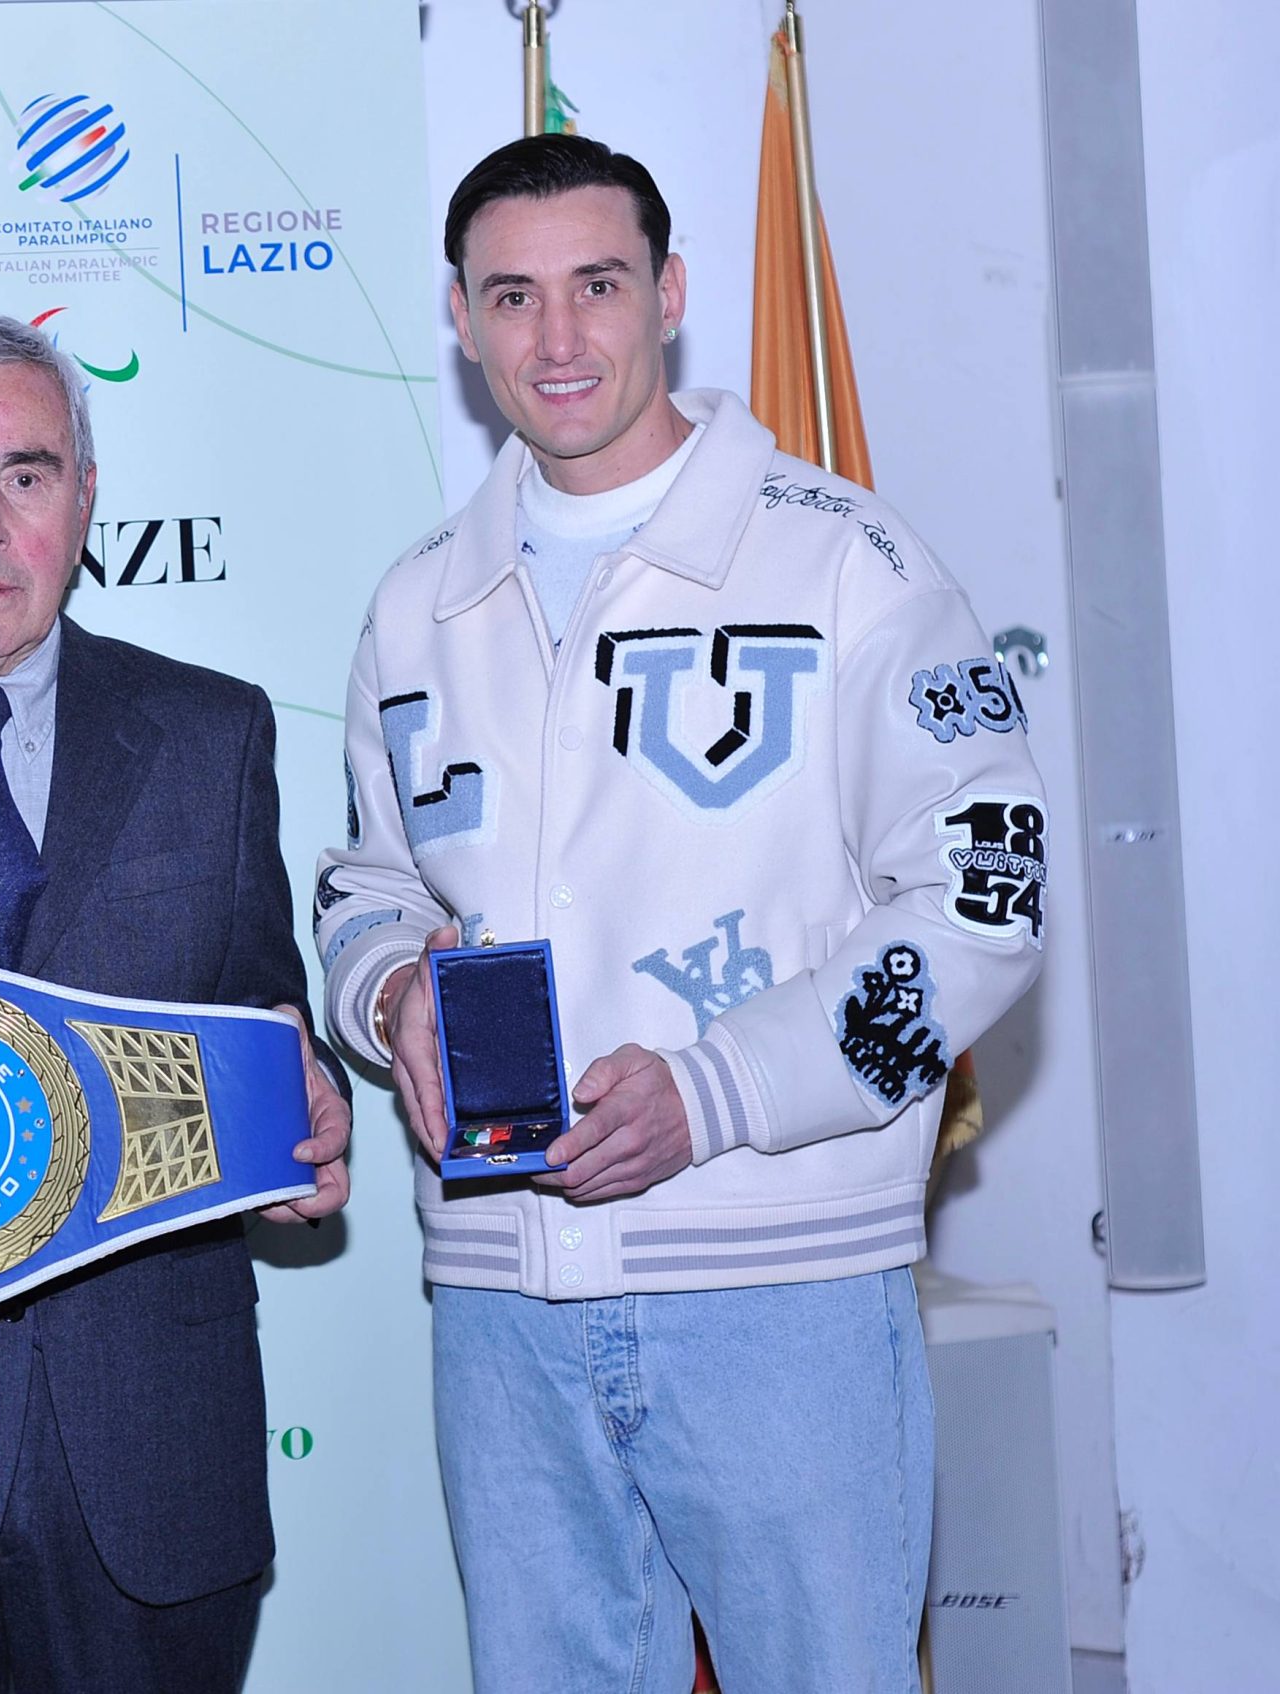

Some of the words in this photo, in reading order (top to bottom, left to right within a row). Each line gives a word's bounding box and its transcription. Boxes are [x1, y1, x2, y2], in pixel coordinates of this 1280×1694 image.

[78, 217, 153, 232] ITALIANO
[200, 208, 343, 234] REGIONE
[18, 231, 128, 247] PARALIMPICO
[57, 255, 159, 271] PARALYMPIC
[202, 240, 334, 275] LAZIO
[27, 270, 121, 285] COMMITTEE
[929, 1590, 1018, 1610] BOSE
